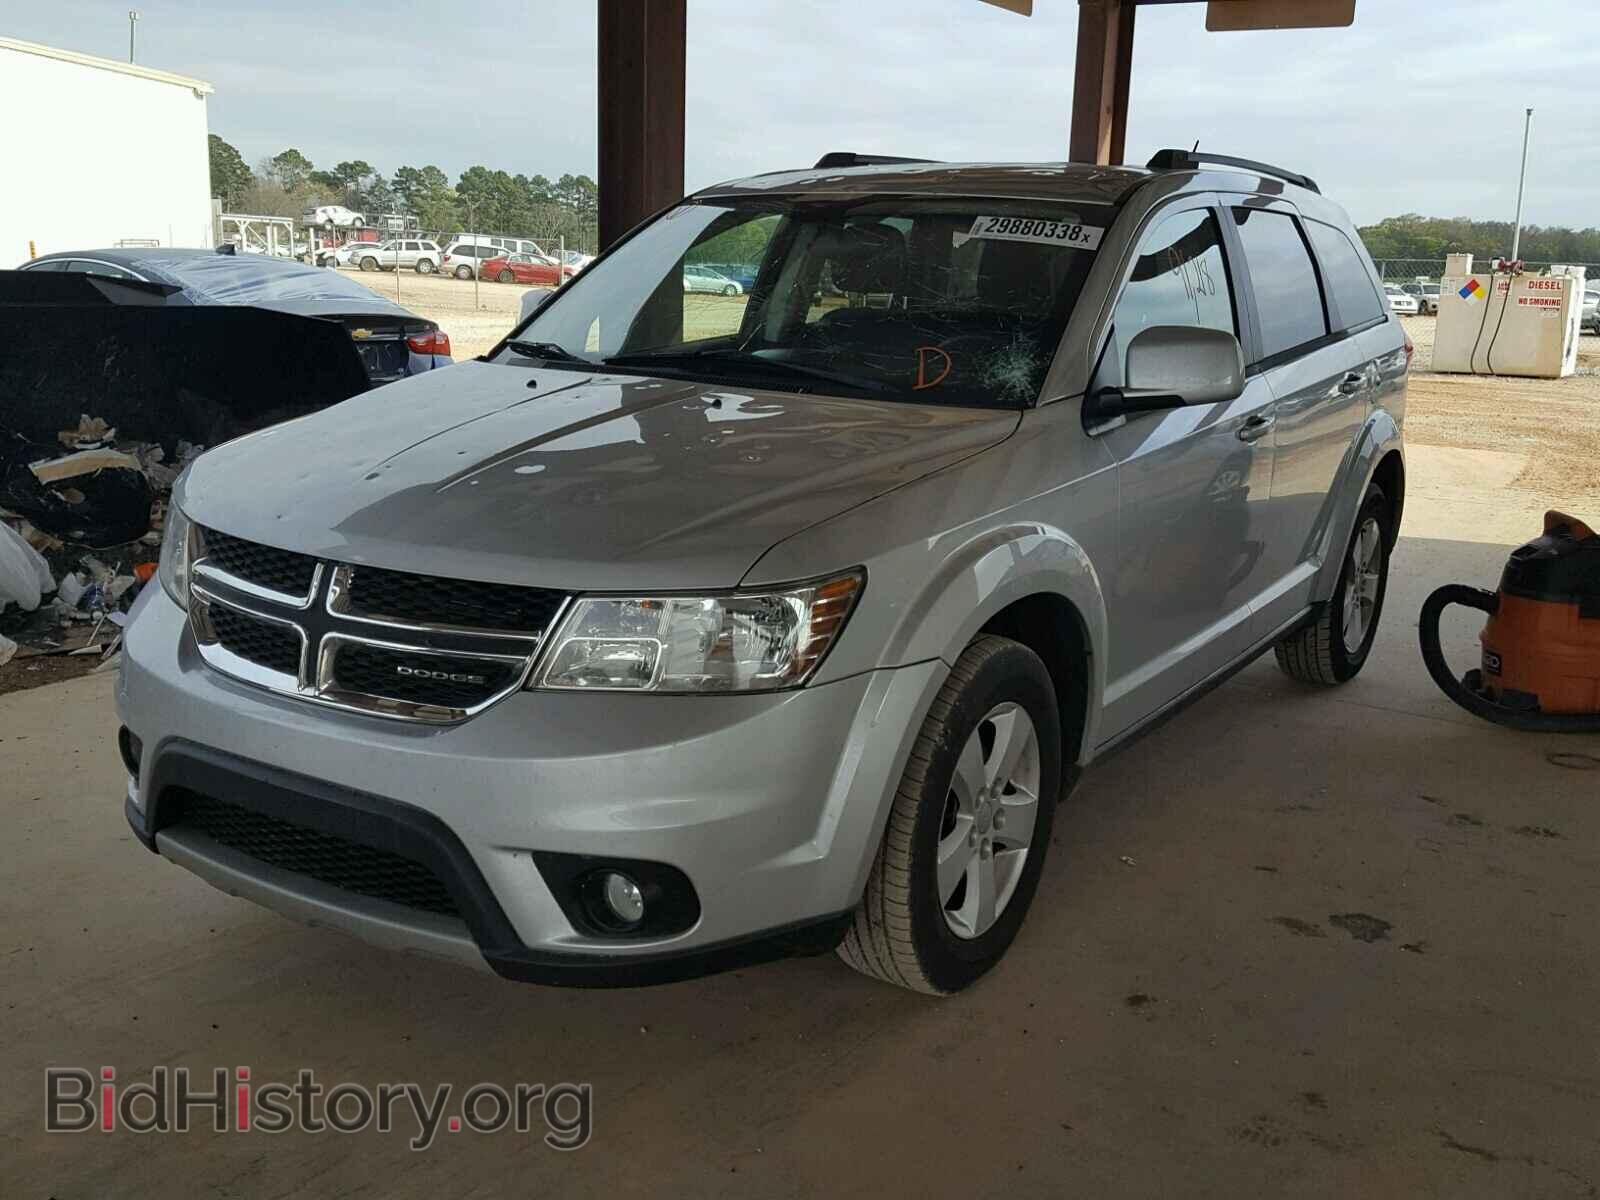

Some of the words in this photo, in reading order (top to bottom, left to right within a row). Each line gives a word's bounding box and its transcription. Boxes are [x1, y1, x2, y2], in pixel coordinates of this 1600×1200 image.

[1528, 280, 1561, 290] DIESEL
[1518, 297, 1528, 305] NO
[1529, 297, 1561, 307] SMOKING
[912, 346, 952, 390] D
[397, 666, 485, 684] DODGE
